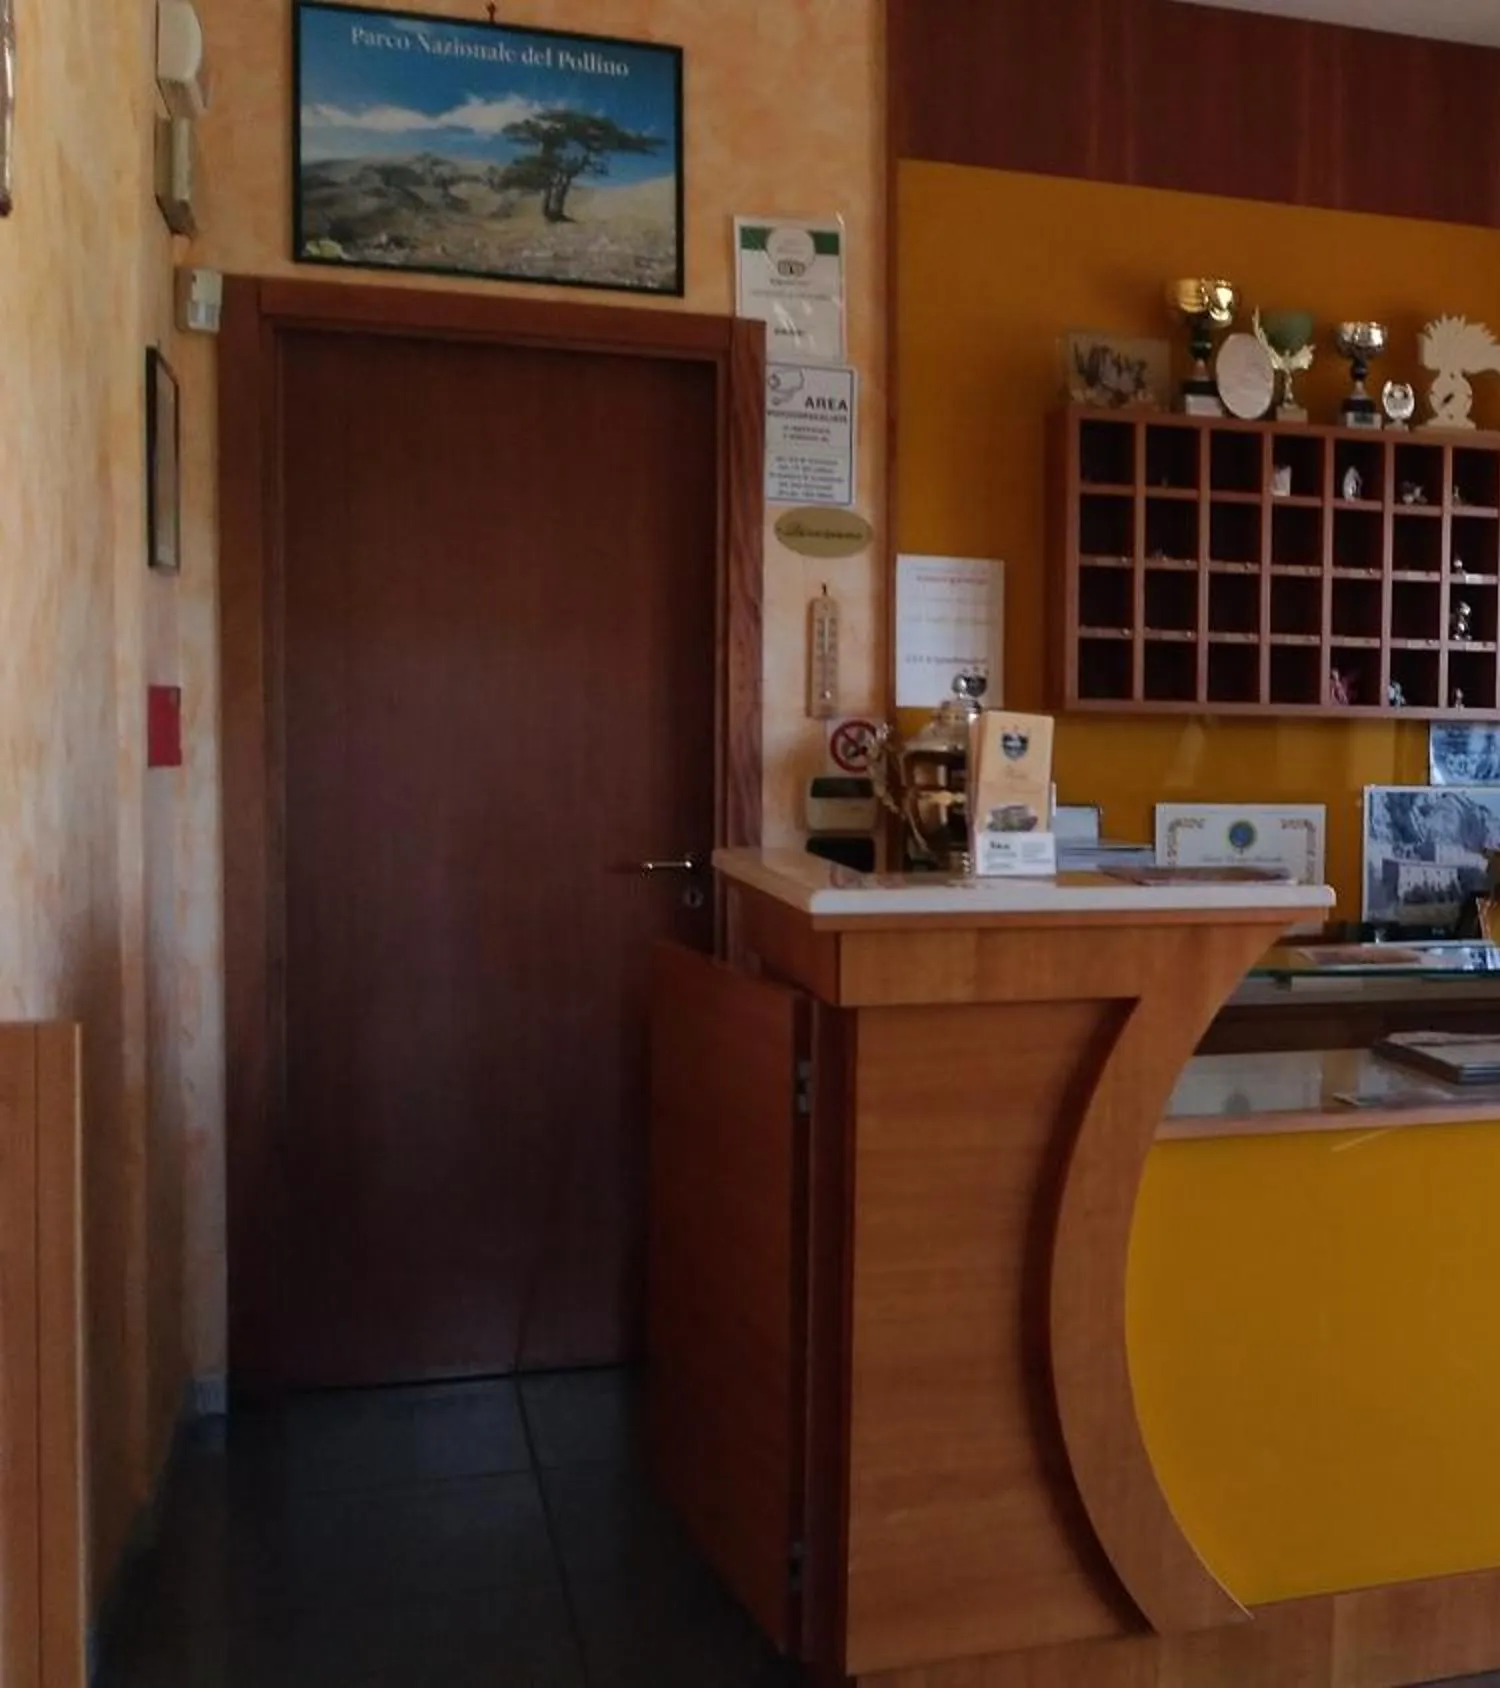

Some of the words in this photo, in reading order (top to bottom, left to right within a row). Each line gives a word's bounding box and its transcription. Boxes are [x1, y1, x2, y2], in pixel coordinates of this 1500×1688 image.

[351, 27, 409, 50] Parco
[417, 34, 515, 63] Nazionale
[522, 48, 552, 67] del
[559, 52, 630, 76] Pollino
[804, 396, 848, 411] AREA
